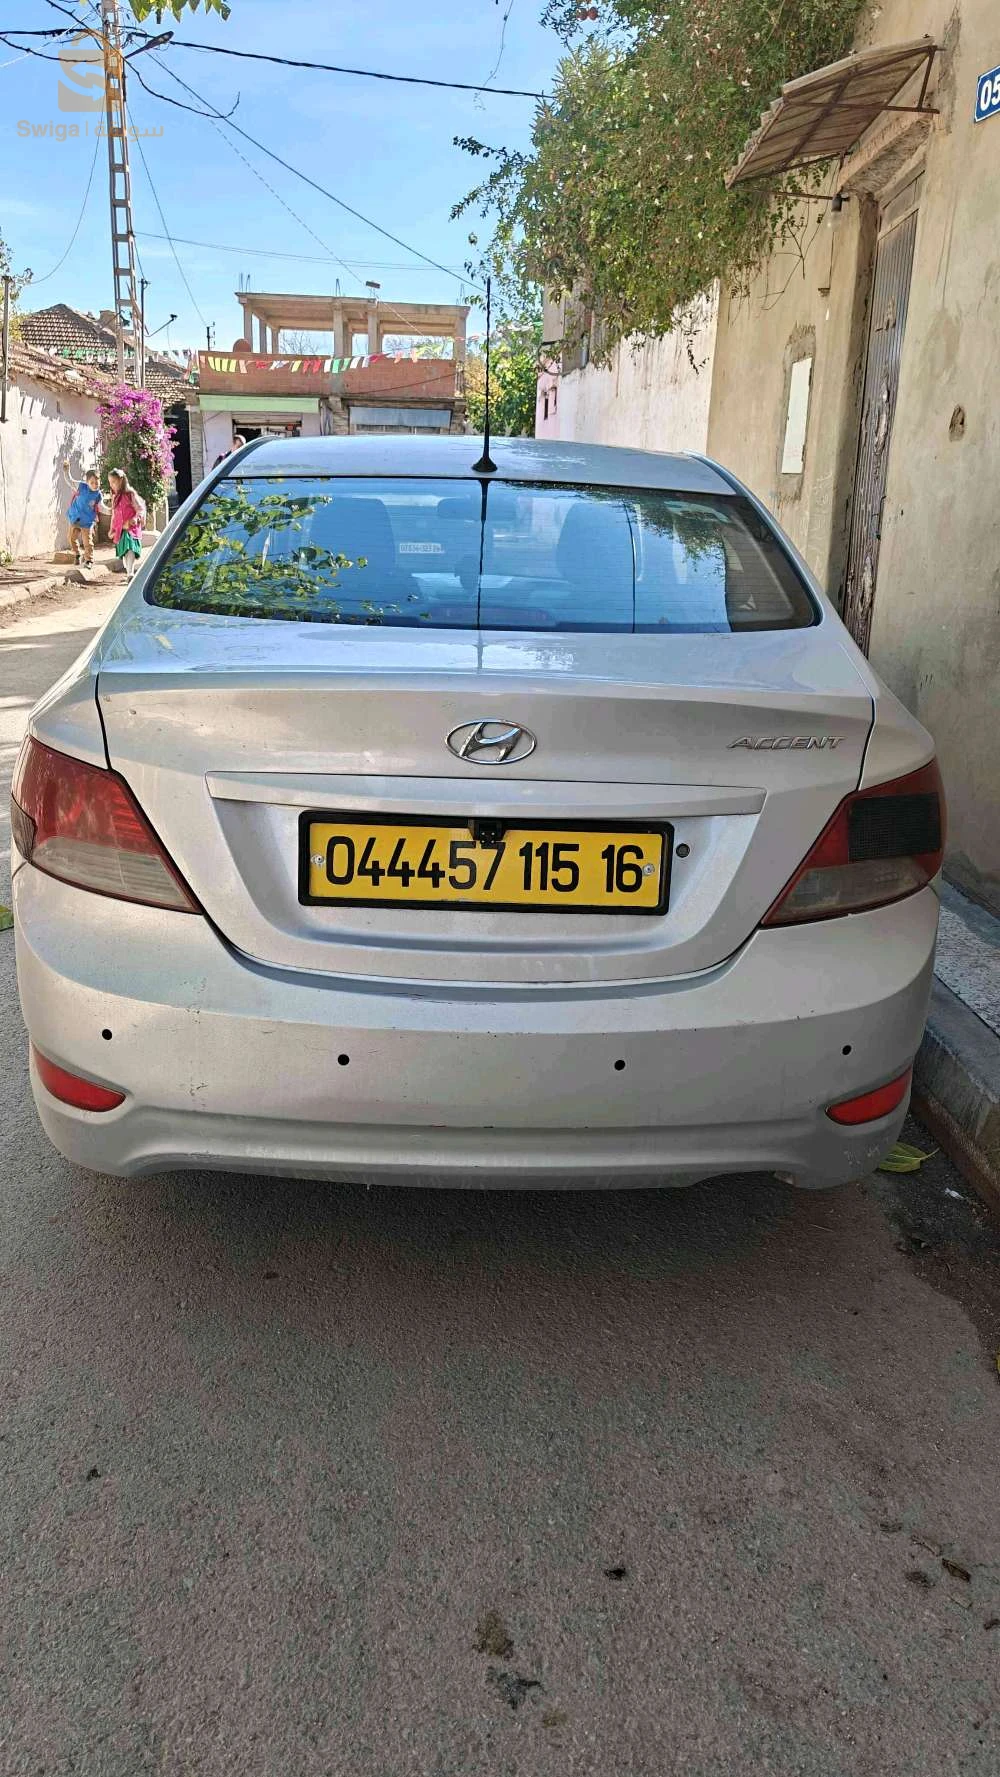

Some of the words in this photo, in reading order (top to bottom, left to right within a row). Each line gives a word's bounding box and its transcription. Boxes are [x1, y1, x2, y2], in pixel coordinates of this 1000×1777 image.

[725, 735, 846, 750] ACCENT
[325, 835, 507, 891] 044457
[519, 842, 579, 892] 115
[601, 844, 644, 893] 16
